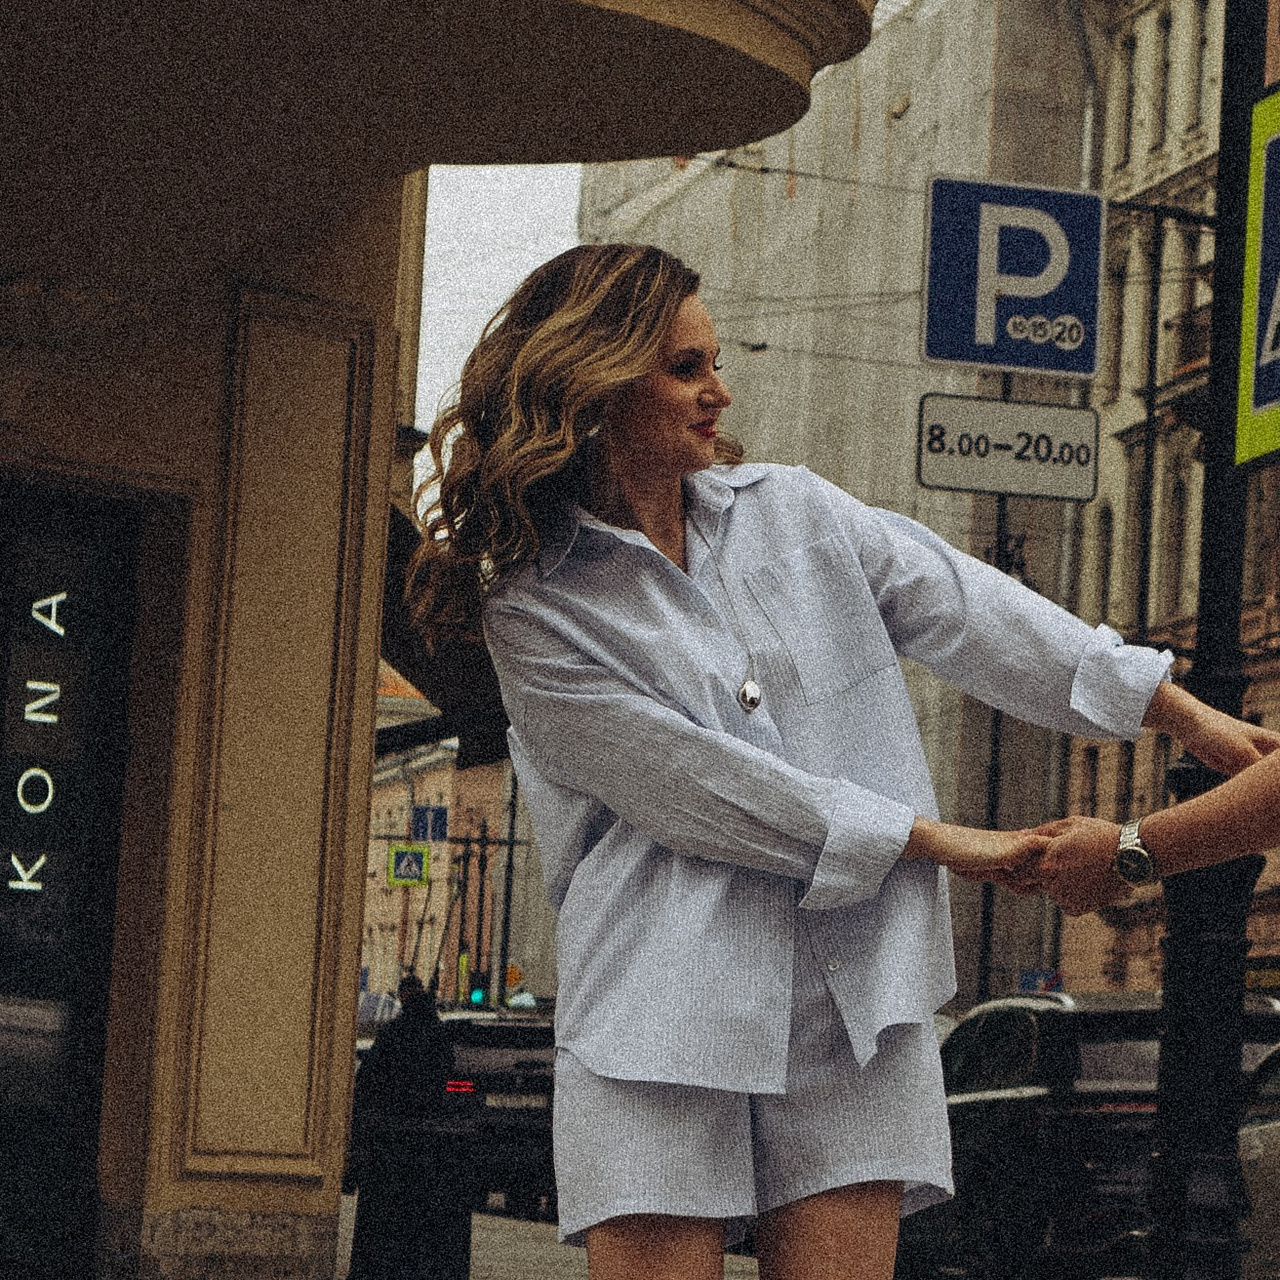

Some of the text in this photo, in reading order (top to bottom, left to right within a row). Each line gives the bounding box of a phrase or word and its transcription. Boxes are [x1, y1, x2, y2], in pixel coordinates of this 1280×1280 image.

[974, 201, 1071, 346] P
[1054, 321, 1082, 343] 20
[8, 591, 68, 892] KONA
